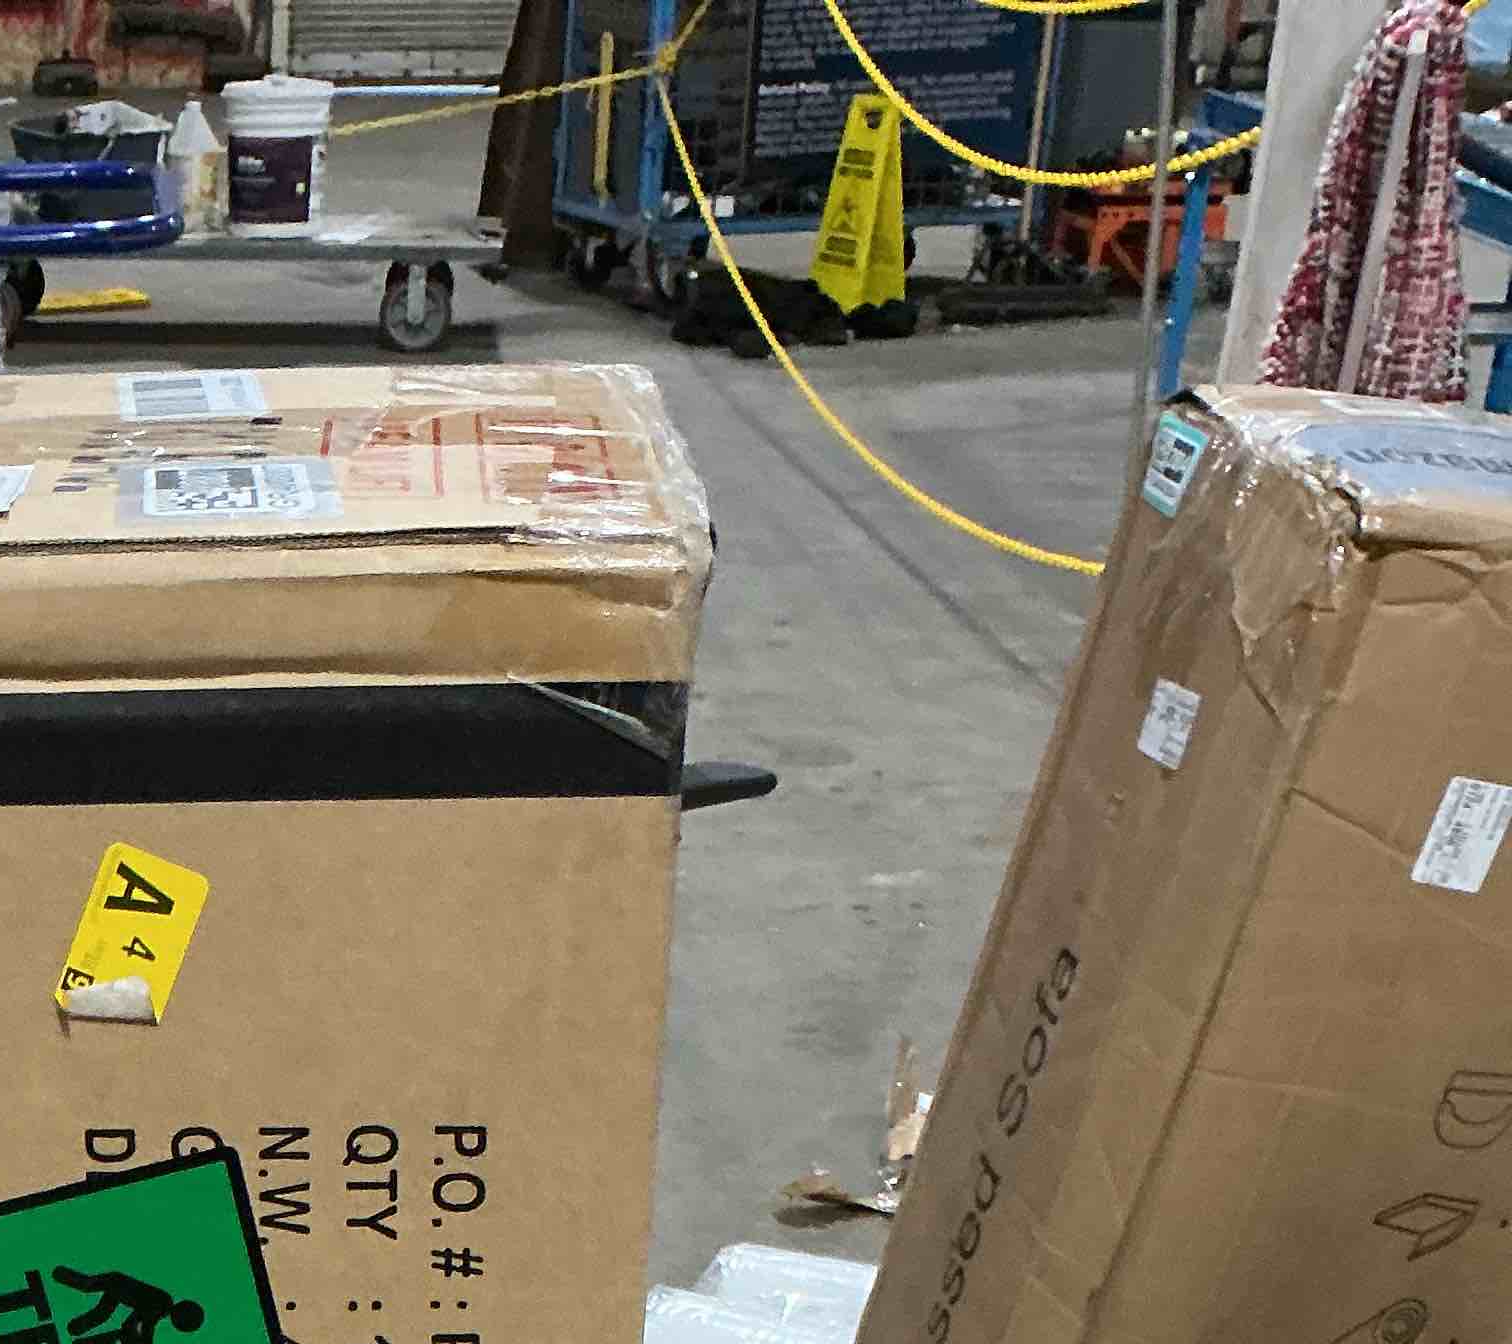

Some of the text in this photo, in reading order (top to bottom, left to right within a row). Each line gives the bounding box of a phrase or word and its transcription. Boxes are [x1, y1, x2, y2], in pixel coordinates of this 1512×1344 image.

[103, 858, 177, 921] A
[121, 933, 158, 965] 4
[997, 945, 1079, 1139] Sofa
[343, 1124, 400, 1241] QTY
